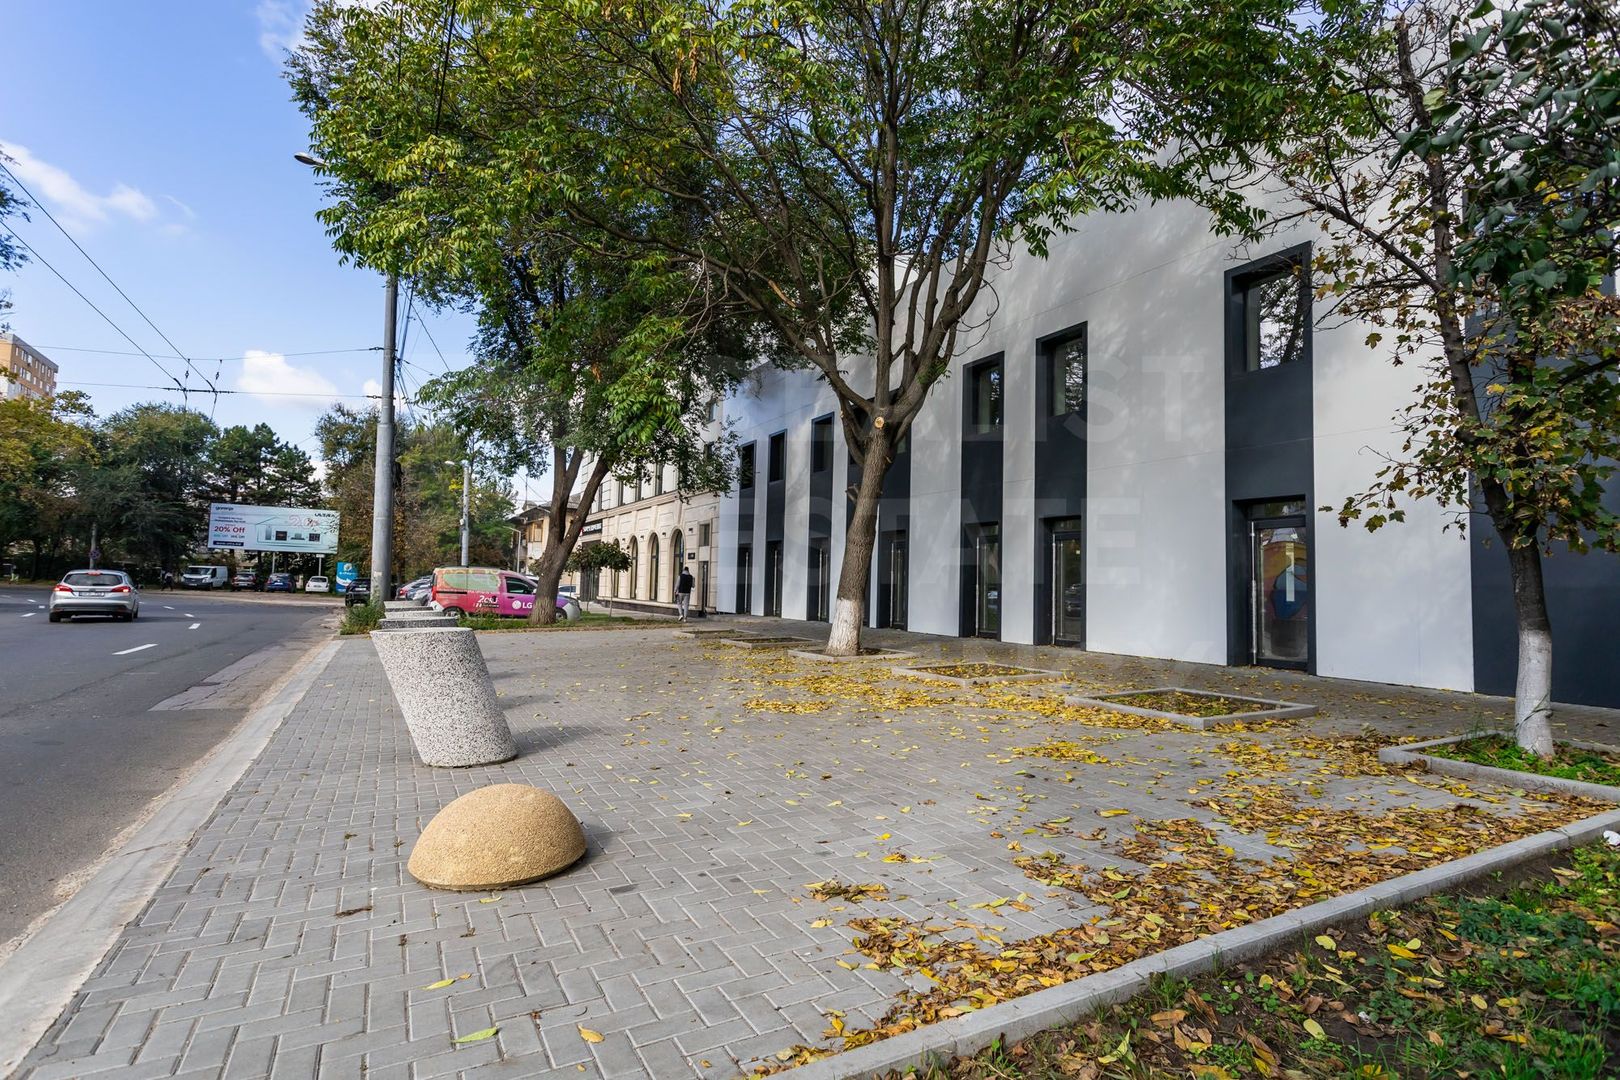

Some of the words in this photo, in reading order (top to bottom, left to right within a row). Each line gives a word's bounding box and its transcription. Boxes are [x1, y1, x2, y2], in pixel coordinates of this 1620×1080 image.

[214, 525, 231, 533] 20%
[232, 526, 246, 534] Off
[522, 601, 533, 609] LG
